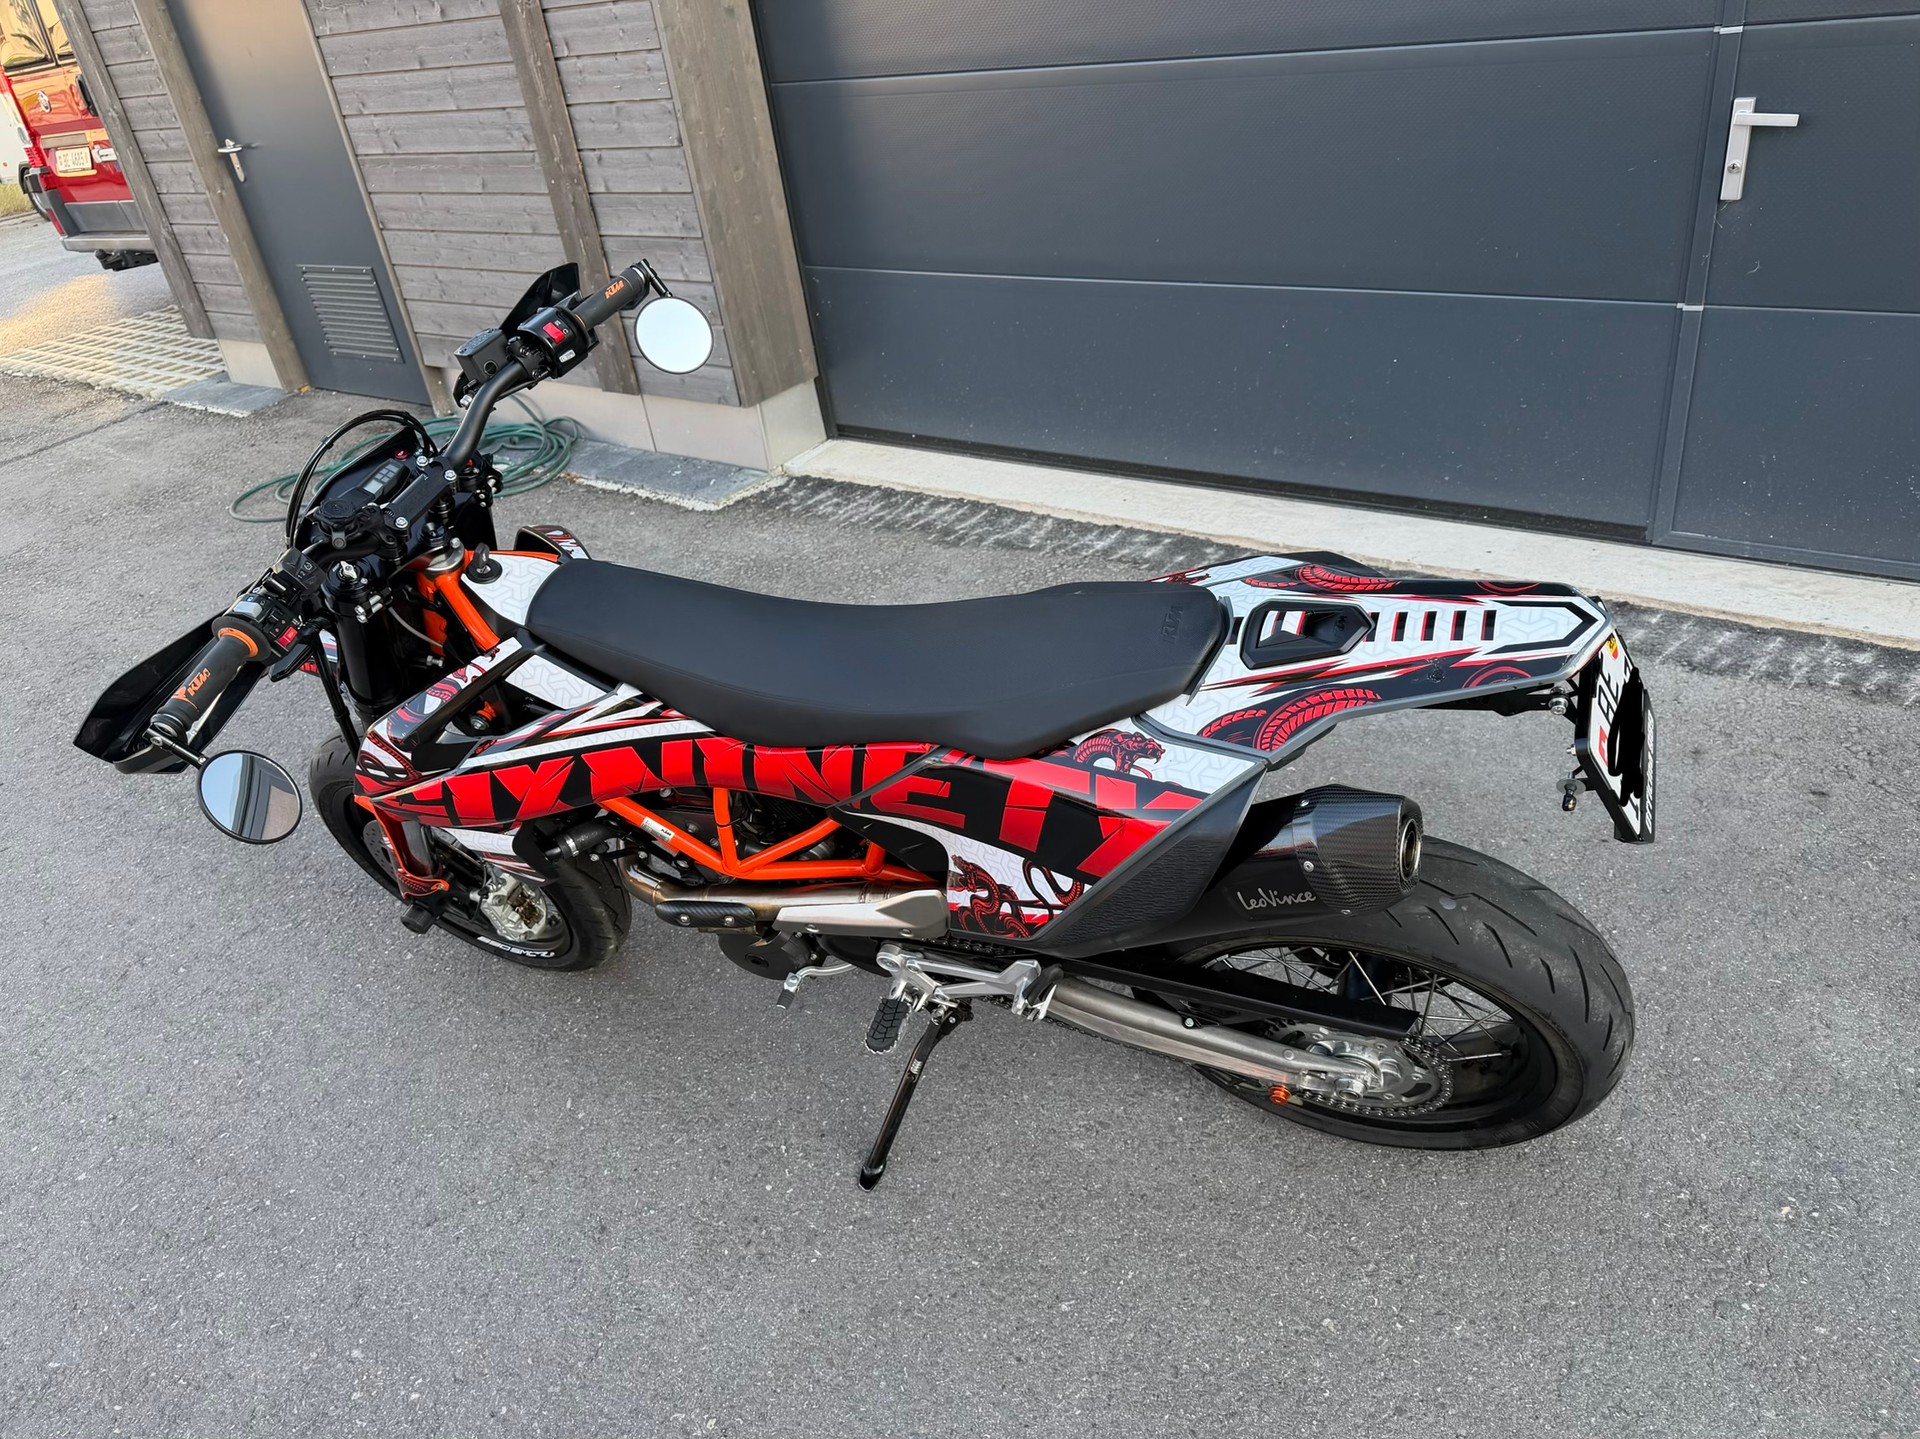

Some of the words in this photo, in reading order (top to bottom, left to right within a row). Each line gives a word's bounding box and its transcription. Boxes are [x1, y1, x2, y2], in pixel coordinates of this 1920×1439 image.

[604, 279, 625, 299] KTM
[1161, 605, 1184, 643] KTM
[187, 668, 212, 696] KTM
[1237, 887, 1316, 911] LeoVince
